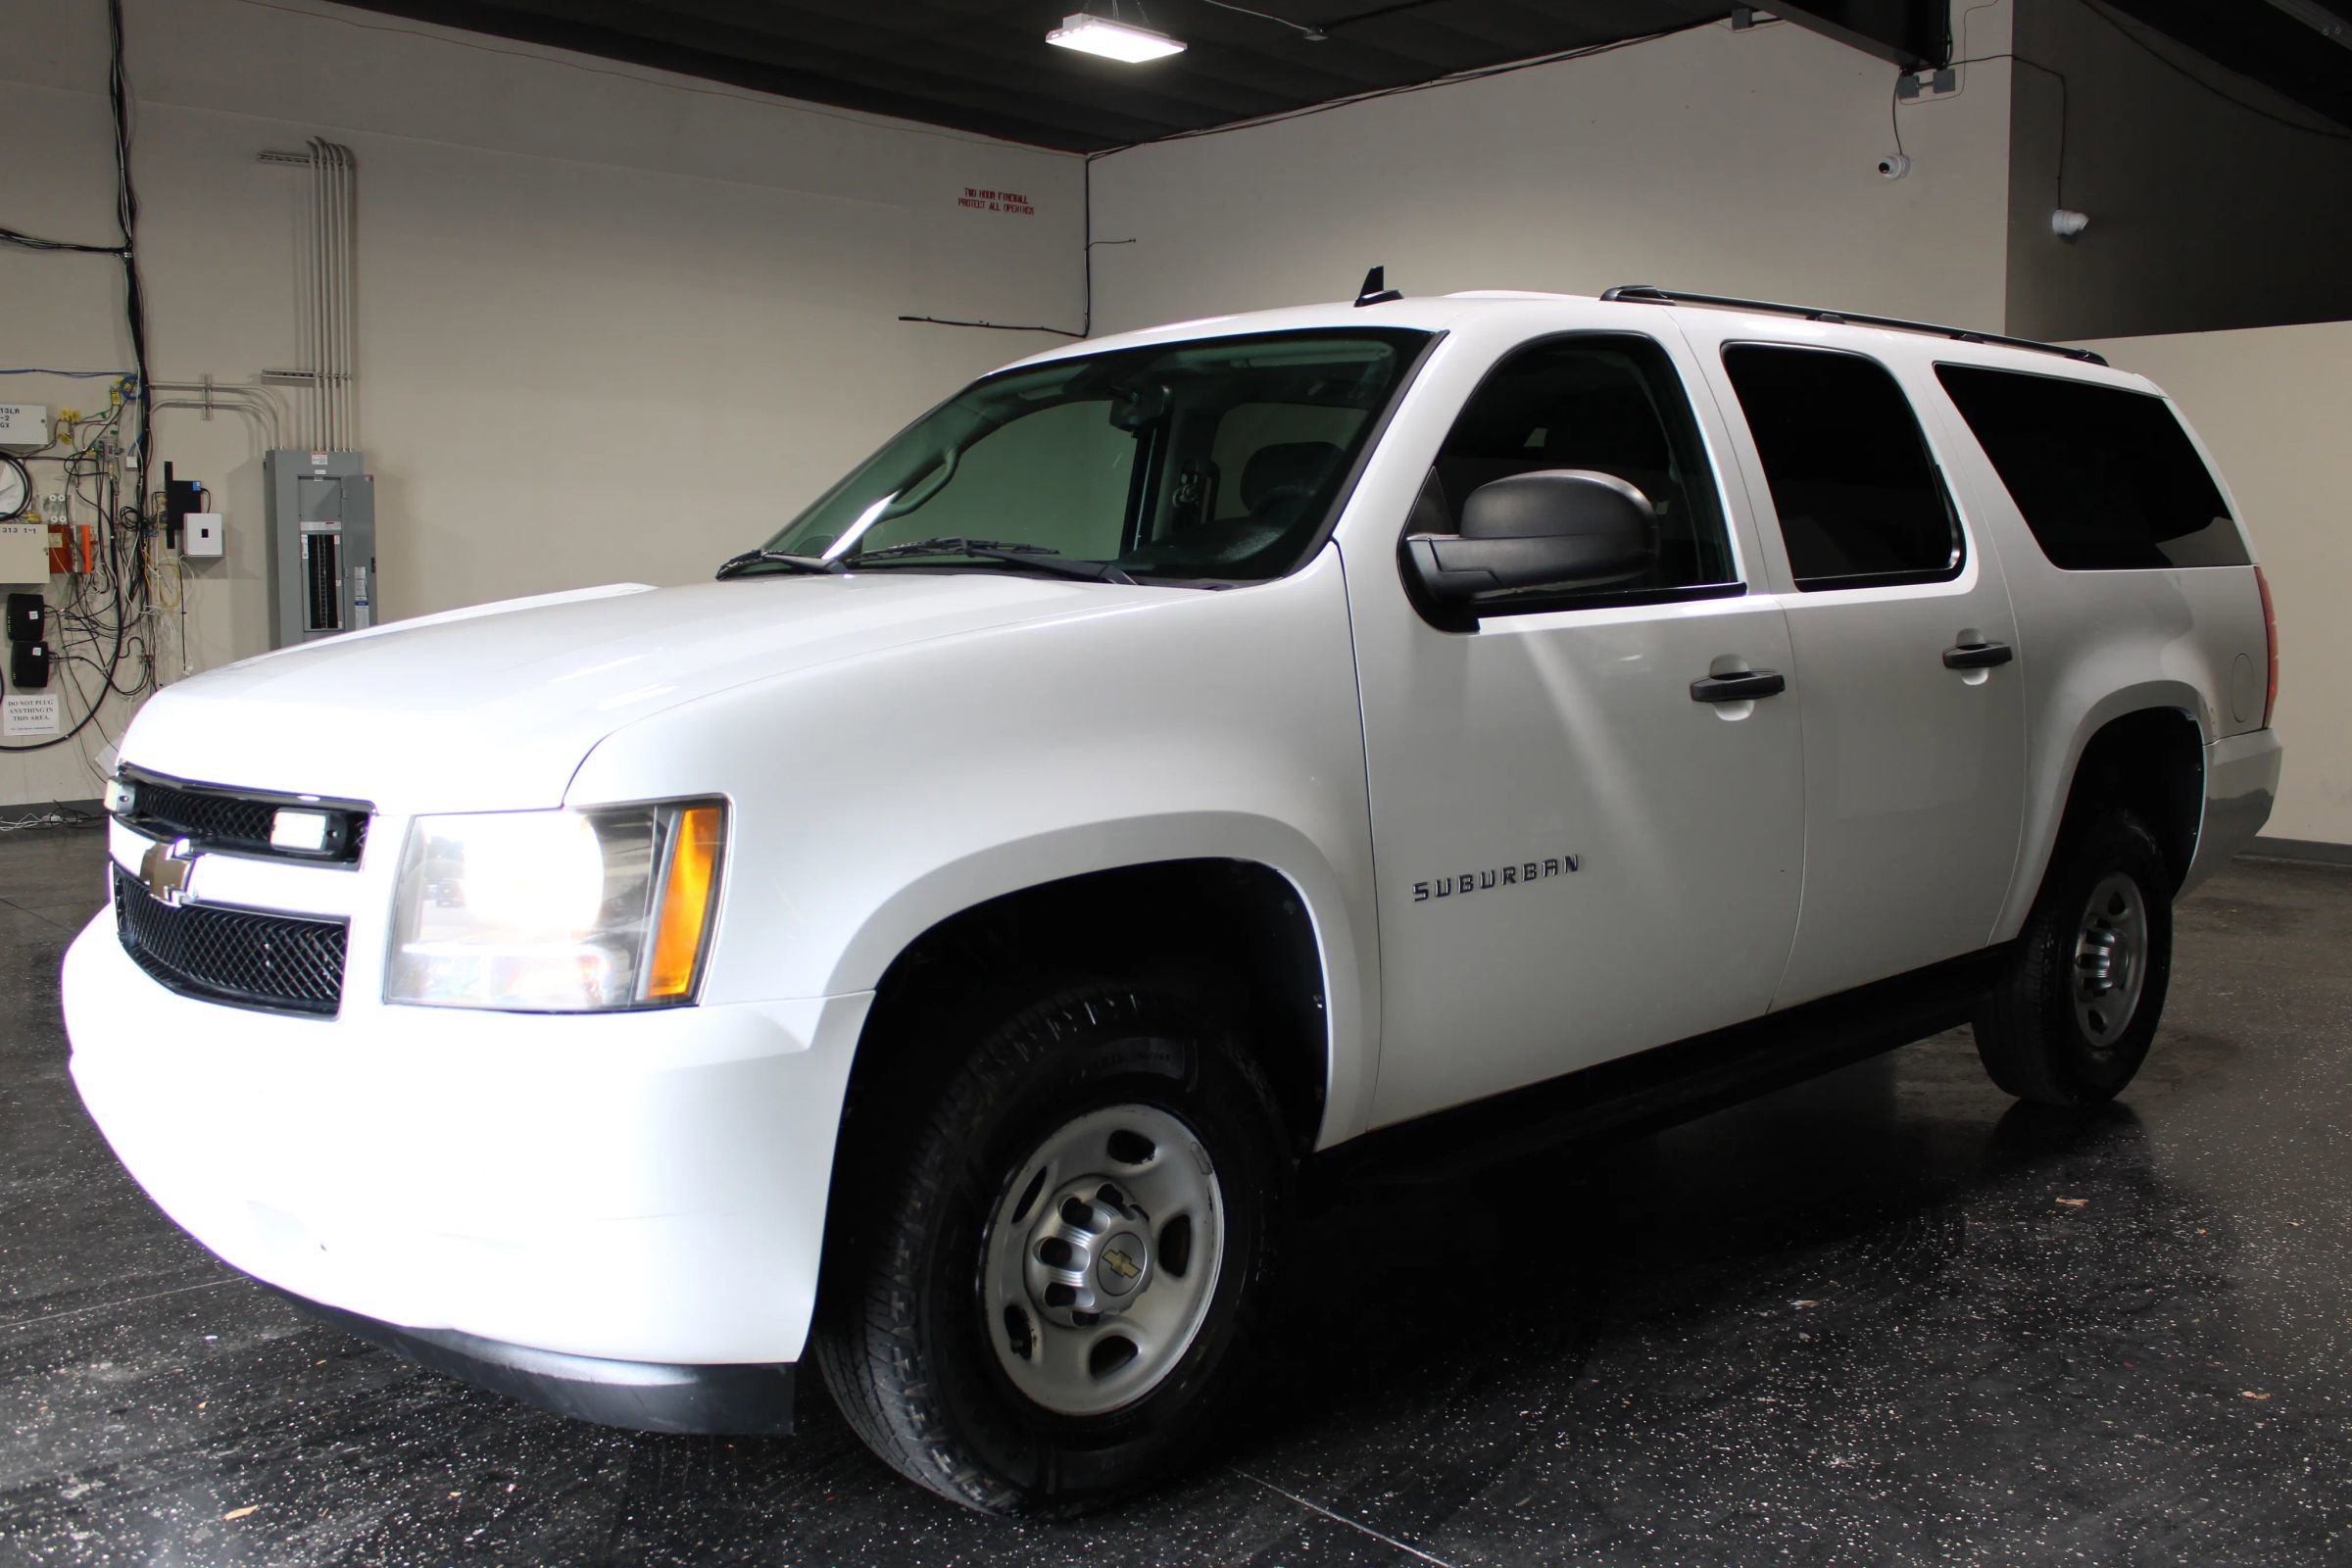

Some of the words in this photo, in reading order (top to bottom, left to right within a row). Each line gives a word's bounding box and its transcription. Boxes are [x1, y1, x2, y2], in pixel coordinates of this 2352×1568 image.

[964, 187, 977, 197] TWO
[979, 189, 996, 200] HOUR
[957, 197, 986, 210] PROTECT
[989, 202, 1002, 212] ALL
[1413, 854, 1579, 903] SUBURBAN
